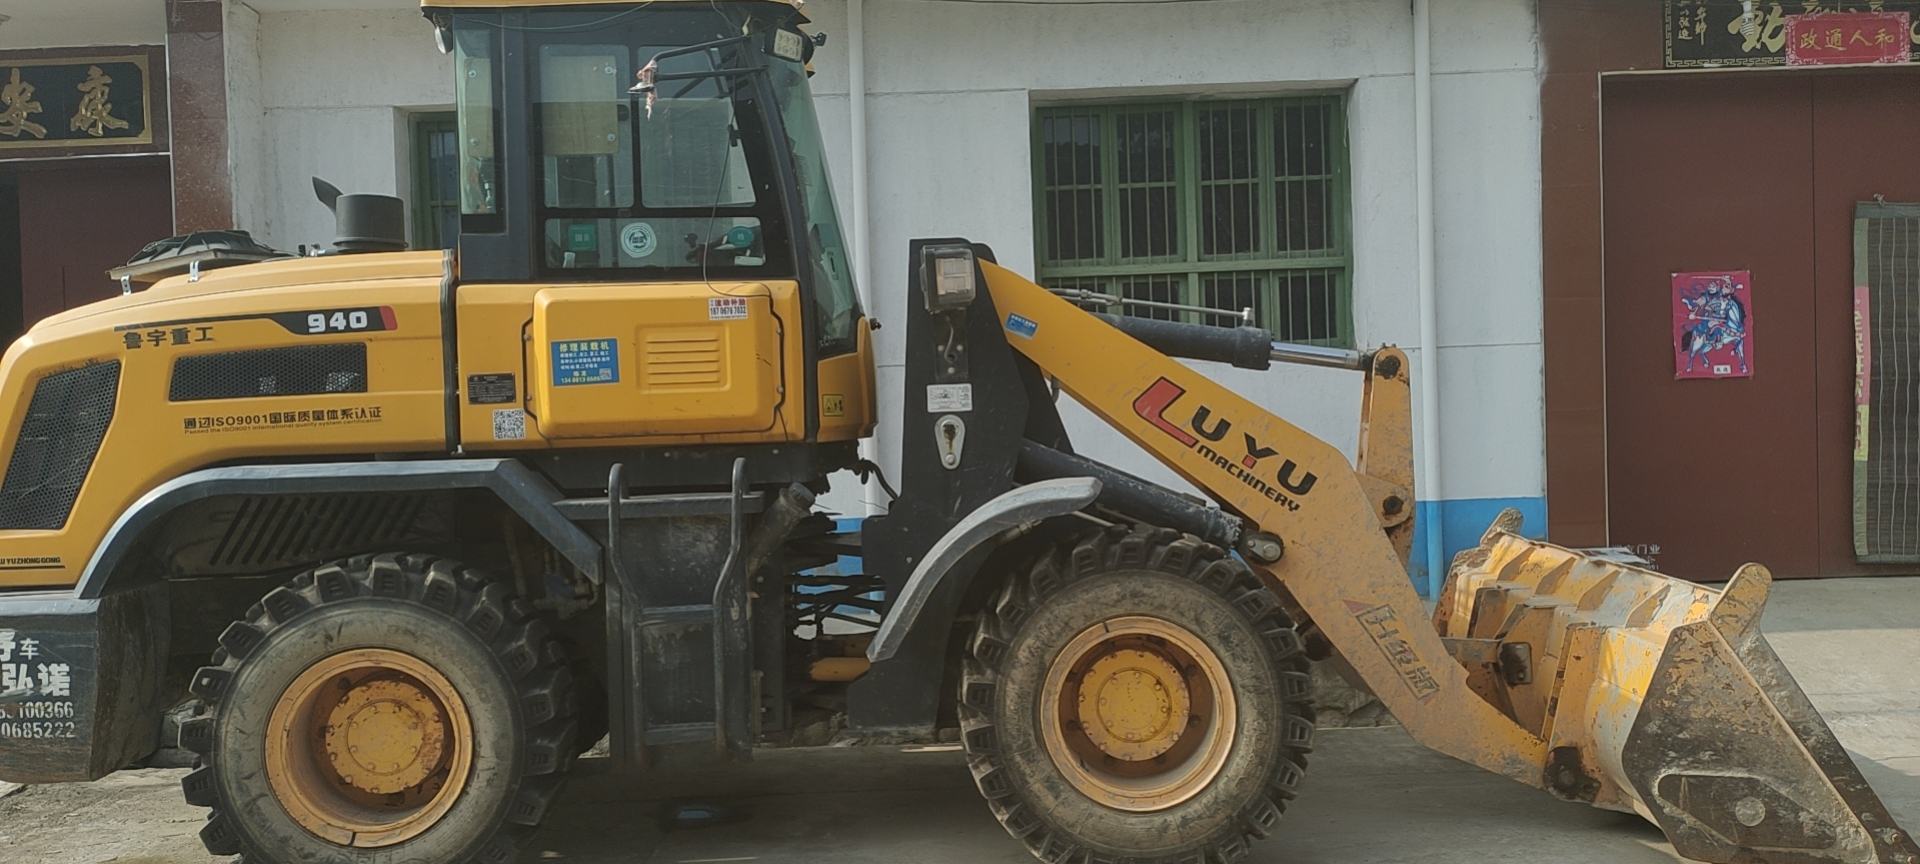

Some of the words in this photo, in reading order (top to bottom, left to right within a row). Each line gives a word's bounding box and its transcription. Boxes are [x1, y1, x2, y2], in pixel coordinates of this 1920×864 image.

[1800, 29, 1895, 50] 政通人和
[308, 311, 367, 333] 940
[123, 327, 214, 349] 鲁宇重工
[1197, 445, 1300, 512] MACHINERY
